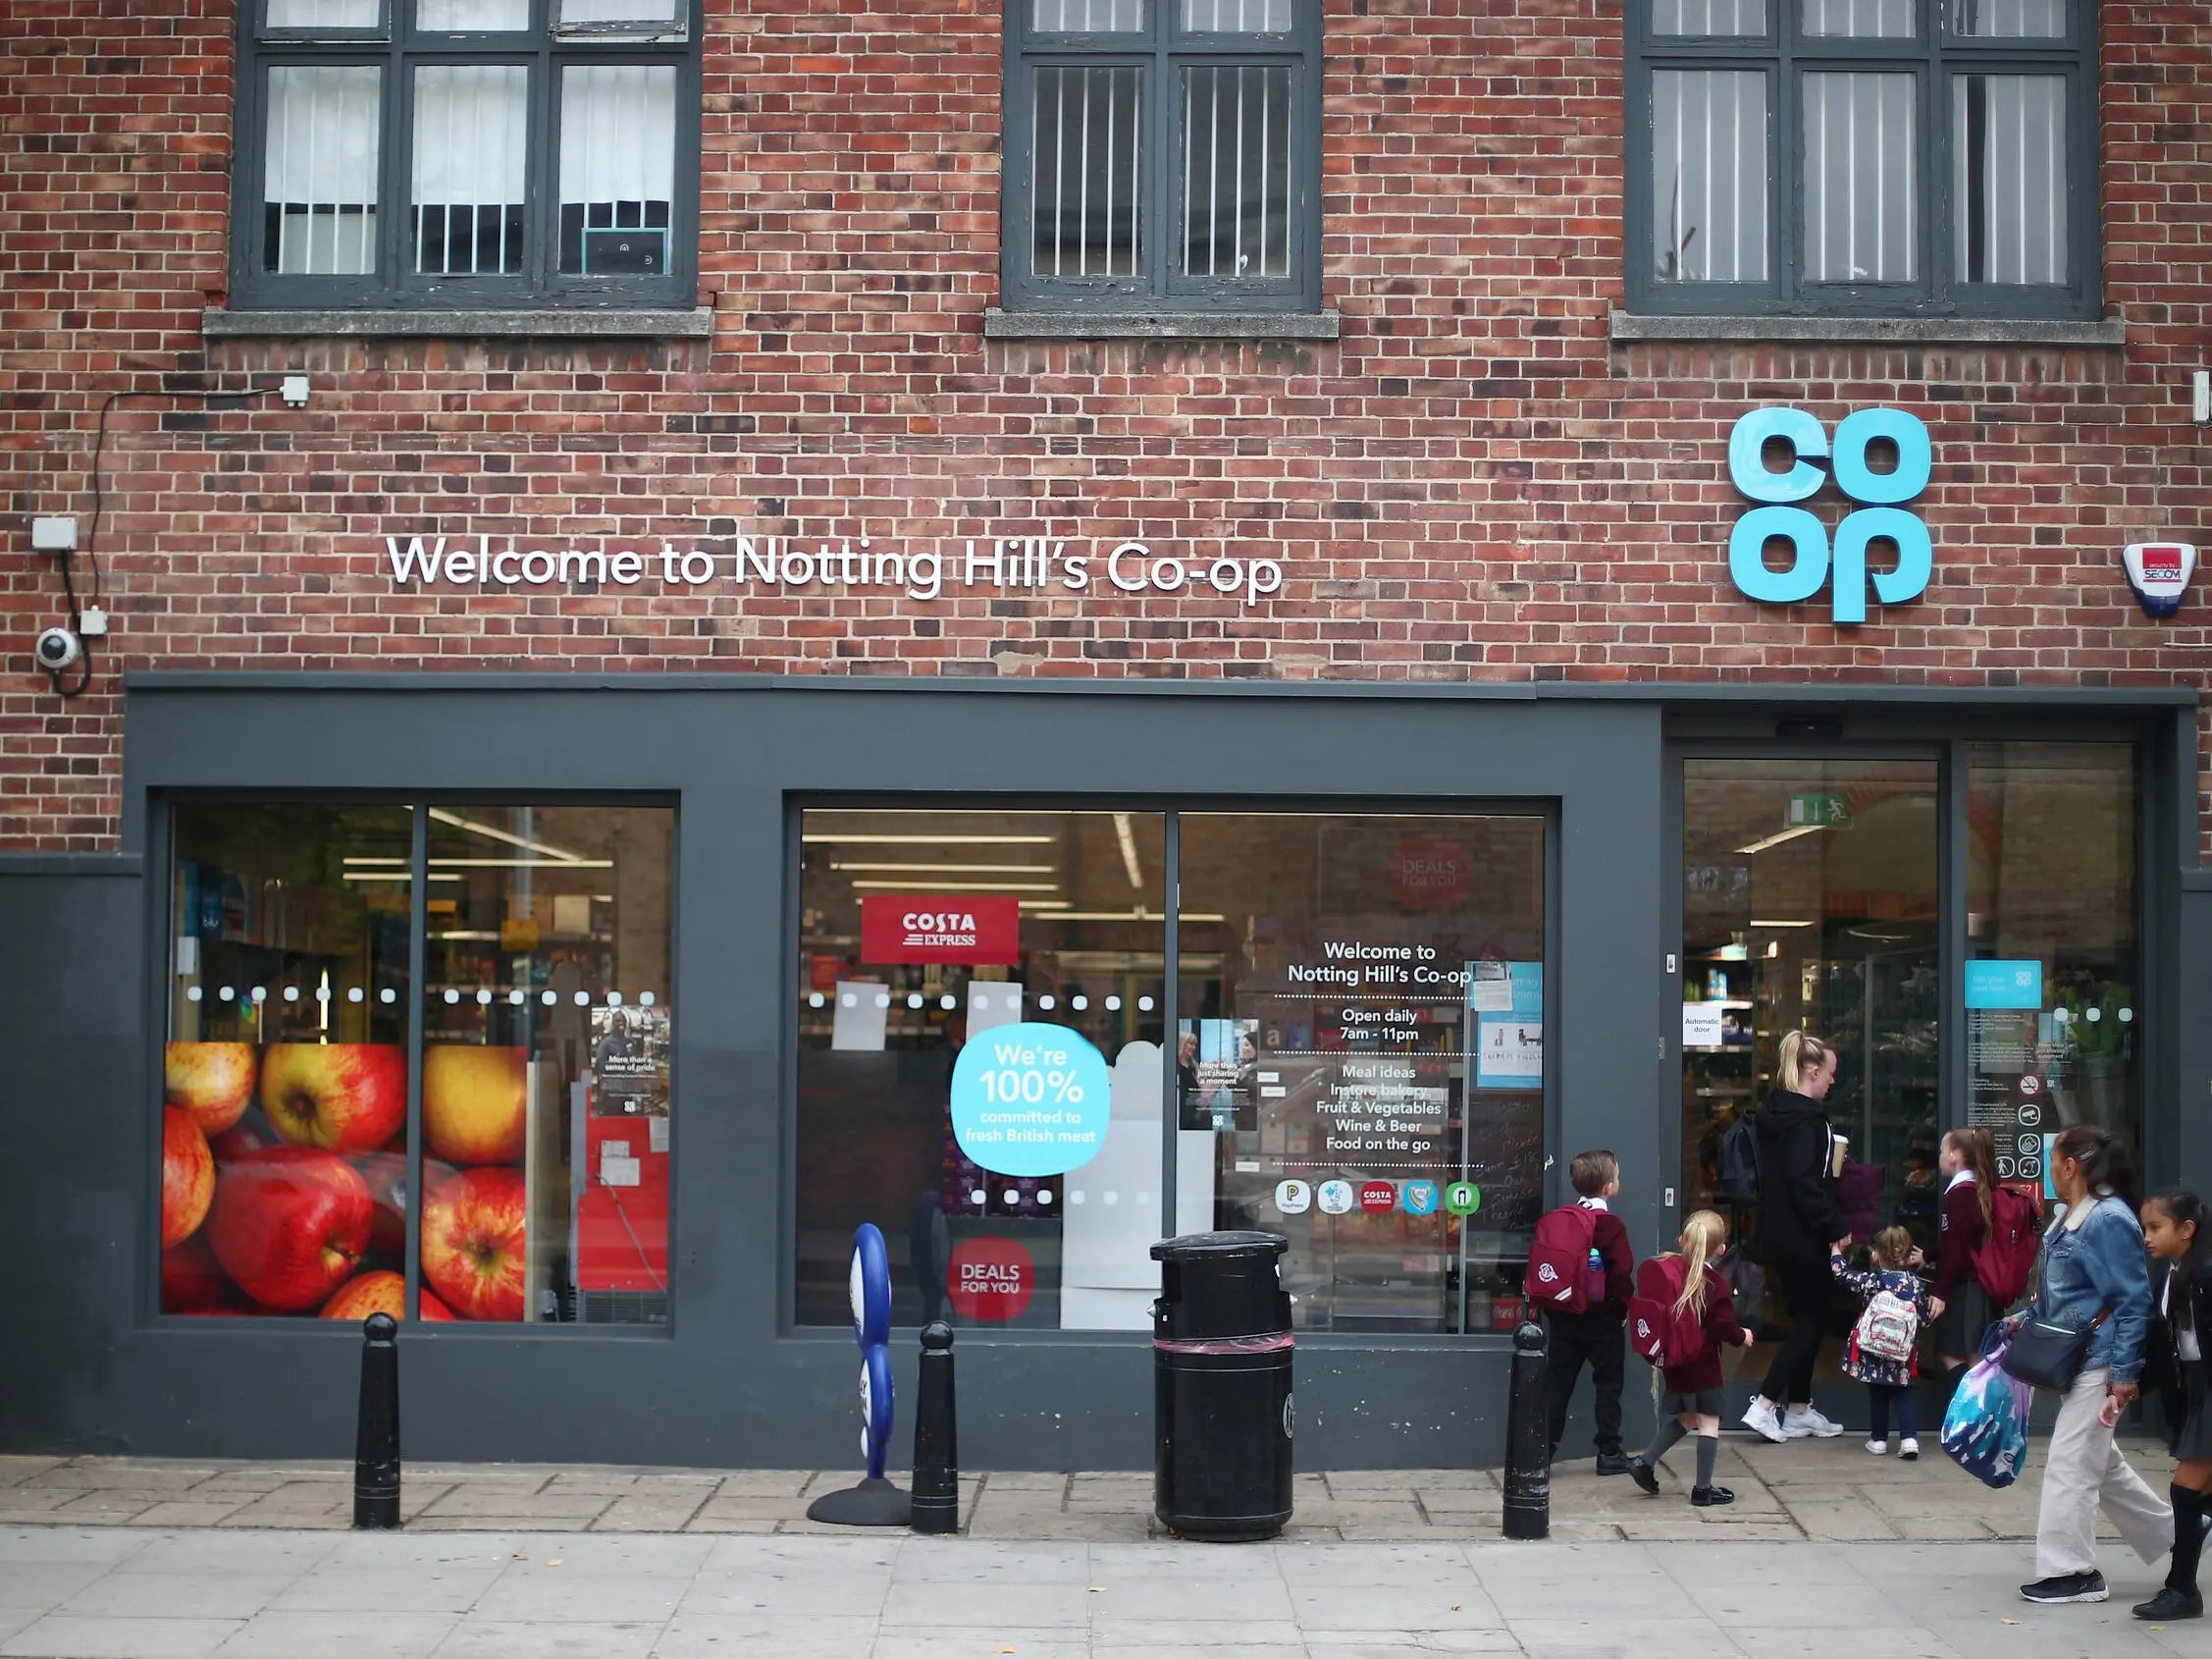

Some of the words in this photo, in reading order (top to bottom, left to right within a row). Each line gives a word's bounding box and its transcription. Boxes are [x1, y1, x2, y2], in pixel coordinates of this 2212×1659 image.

[386, 533, 643, 585] Welcome
[659, 542, 714, 586] to
[735, 537, 942, 602] Notting
[965, 539, 1089, 590] Hill's
[1106, 541, 1283, 608] Co-op
[2144, 569, 2181, 579] SECOM
[903, 912, 976, 934] COSTA
[924, 934, 976, 946] EXPRESS
[1324, 941, 1412, 960] Welcome
[1416, 944, 1436, 960] to
[1288, 964, 1359, 987] Notting
[1365, 965, 1409, 983] Hill's
[1413, 966, 1472, 989] Co-op
[1342, 1008, 1381, 1026] Open
[1385, 1009, 1418, 1025] daily
[1340, 1027, 1369, 1040] 7am
[1382, 1028, 1419, 1044] 11pm
[994, 1044, 1068, 1066] We're
[636, 1064, 656, 1073] pride
[1196, 1069, 1211, 1078] just
[1212, 1069, 1239, 1078] sharing
[1343, 1065, 1376, 1078] Meal
[1380, 1065, 1416, 1079] ideas
[978, 1069, 1084, 1103] 100%
[1330, 1083, 1377, 1096] Instore
[1381, 1083, 1427, 1099] bakery
[979, 1109, 1062, 1124] committed
[1066, 1110, 1081, 1124] to
[1316, 1100, 1347, 1113] Fruit
[1351, 1101, 1362, 1114] &
[1365, 1101, 1442, 1118] Vegetables
[1336, 1119, 1371, 1132] Wine
[1375, 1119, 1386, 1133] &
[1390, 1119, 1422, 1133] Beer
[966, 1127, 1002, 1143] fresh
[1006, 1128, 1053, 1143] British
[1058, 1130, 1096, 1143] meat
[1326, 1137, 1361, 1150] Food
[1365, 1140, 1383, 1151] on
[1386, 1137, 1408, 1151] the
[1412, 1140, 1431, 1154] go
[961, 1263, 1020, 1281] DEALS
[961, 1281, 988, 1293] FOR
[990, 1281, 1020, 1294] YOU
